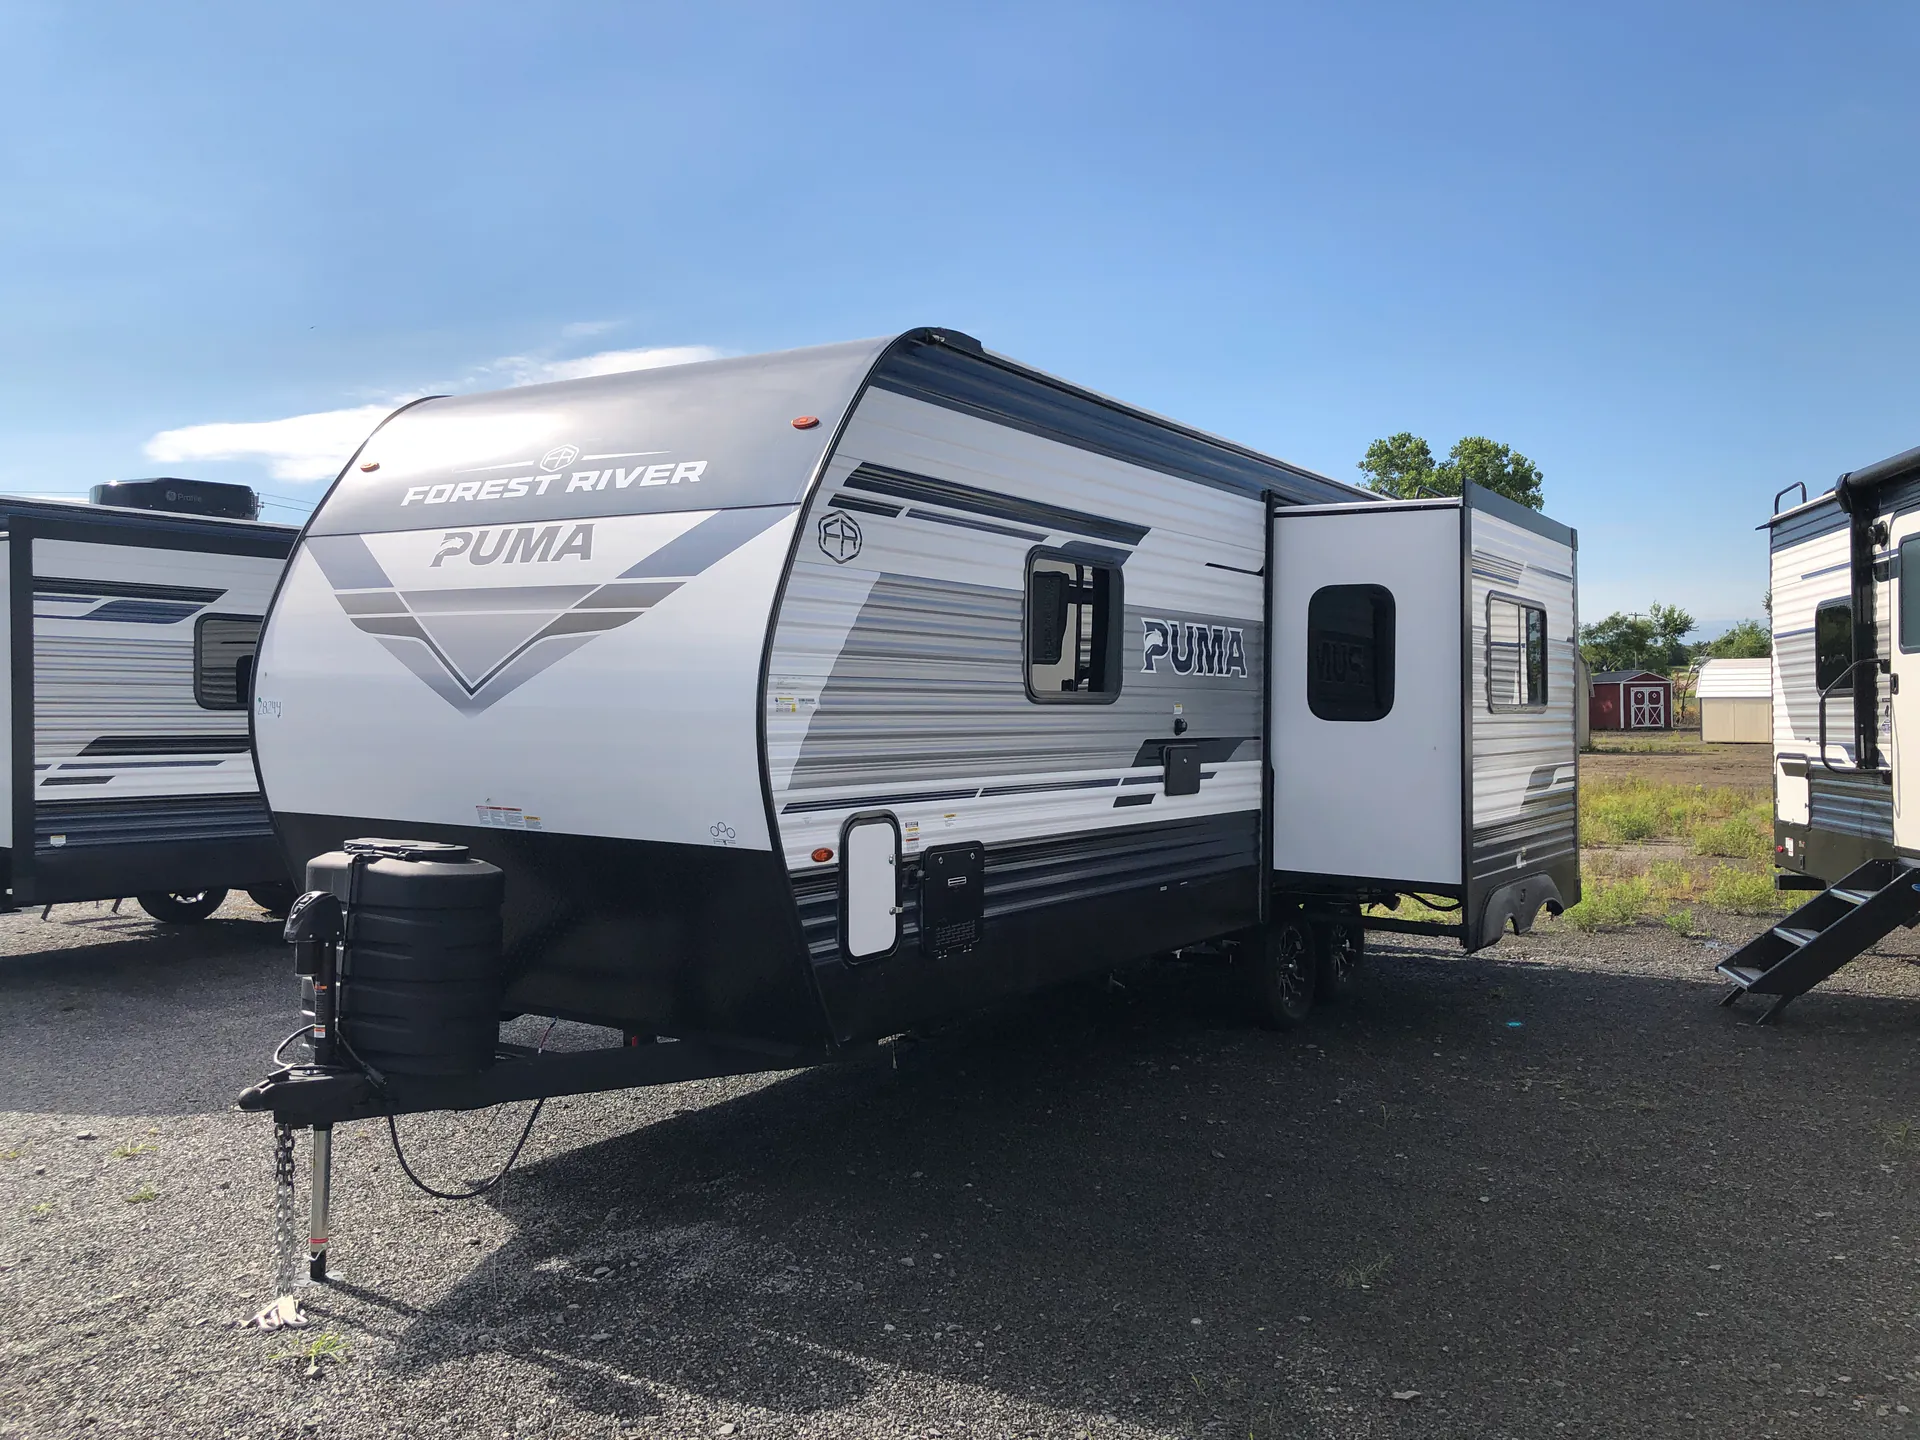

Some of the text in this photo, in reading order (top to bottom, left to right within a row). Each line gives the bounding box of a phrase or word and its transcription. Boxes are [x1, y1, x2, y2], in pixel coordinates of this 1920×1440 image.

[400, 460, 708, 507] FOREST RIVER
[429, 523, 596, 568] PUMA
[1140, 617, 1248, 678] PUMA
